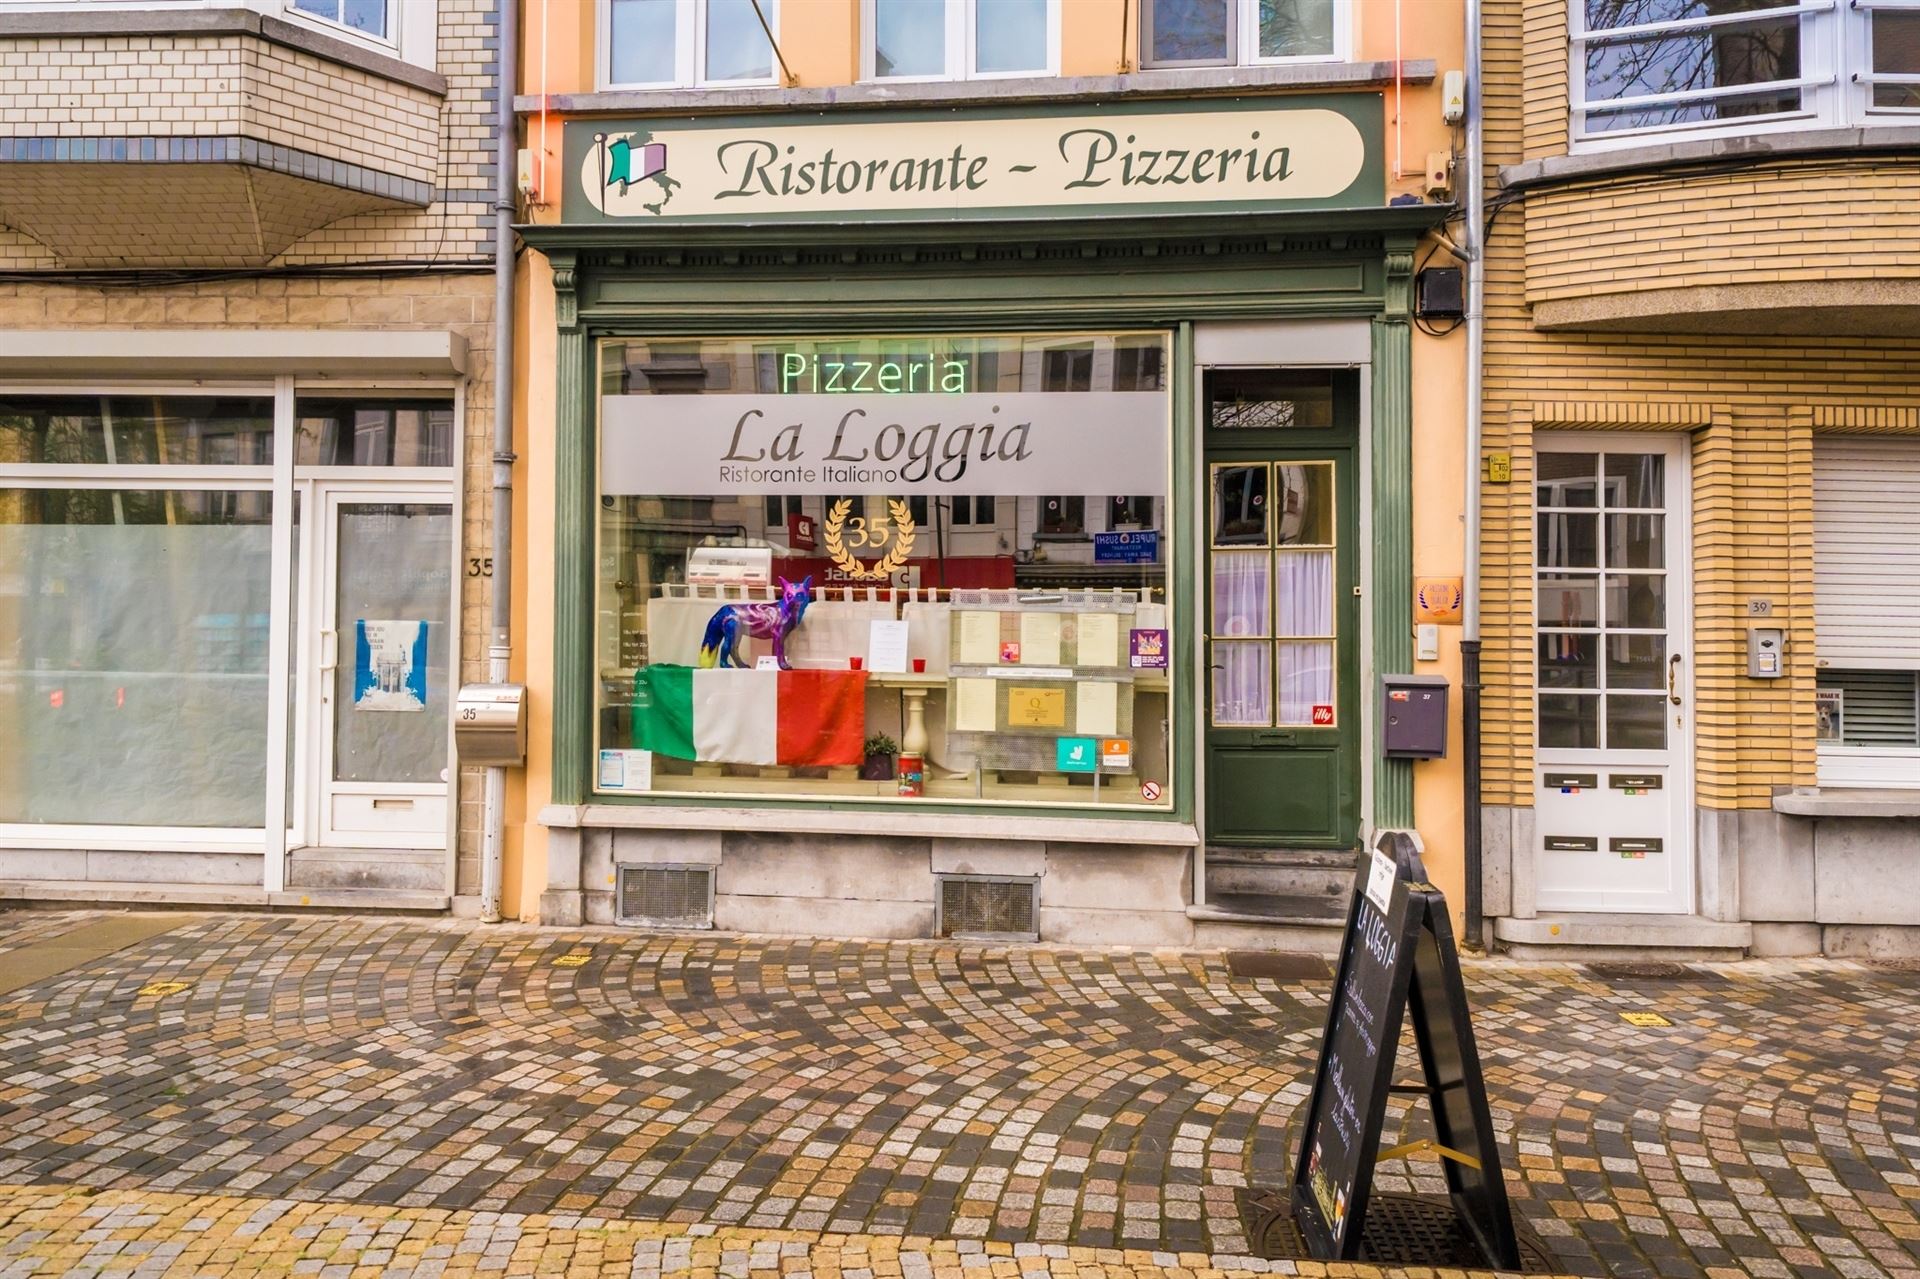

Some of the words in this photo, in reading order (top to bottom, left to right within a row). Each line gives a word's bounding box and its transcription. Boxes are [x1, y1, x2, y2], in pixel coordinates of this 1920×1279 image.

[714, 140, 988, 200] Ristorante
[1058, 129, 1294, 190] Pizzeria
[783, 353, 965, 394] Pizzeria
[720, 409, 804, 462] La
[822, 405, 1033, 483] Loggia
[719, 466, 816, 483] Ristorante
[823, 466, 898, 483] Italiano
[848, 517, 892, 548] 35
[468, 558, 493, 578] 35
[1752, 602, 1767, 612] 39
[463, 708, 477, 720] 35
[1314, 708, 1332, 723] illy
[1357, 898, 1369, 936] LA
[1366, 909, 1397, 970] LOGGIA
